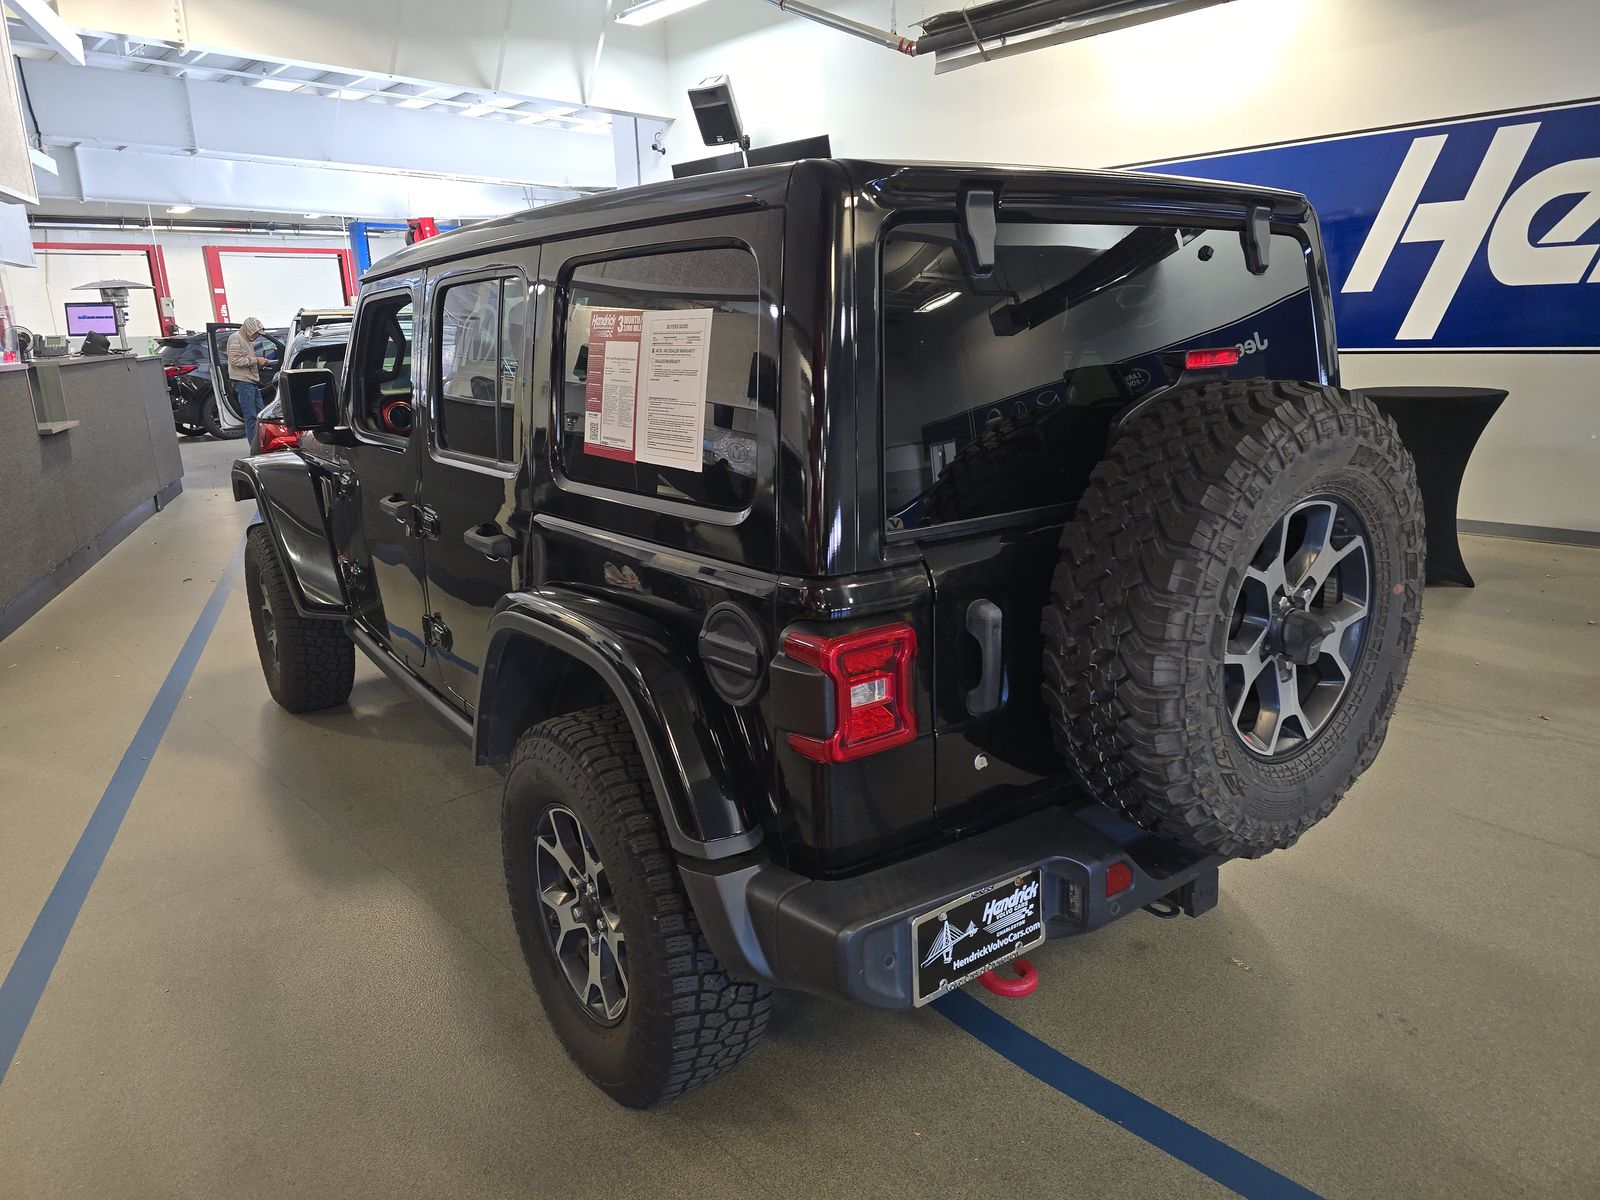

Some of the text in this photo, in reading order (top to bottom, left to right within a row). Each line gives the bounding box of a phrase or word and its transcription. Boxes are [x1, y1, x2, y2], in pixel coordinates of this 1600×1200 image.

[1341, 121, 1600, 341] He
[616, 315, 624, 333] 3
[982, 880, 1039, 925] Hendrick
[996, 900, 1028, 920] VOLVO CARS
[996, 919, 1026, 938] CHARLESTON
[952, 921, 1041, 970] HendrickVolvoCars.com
